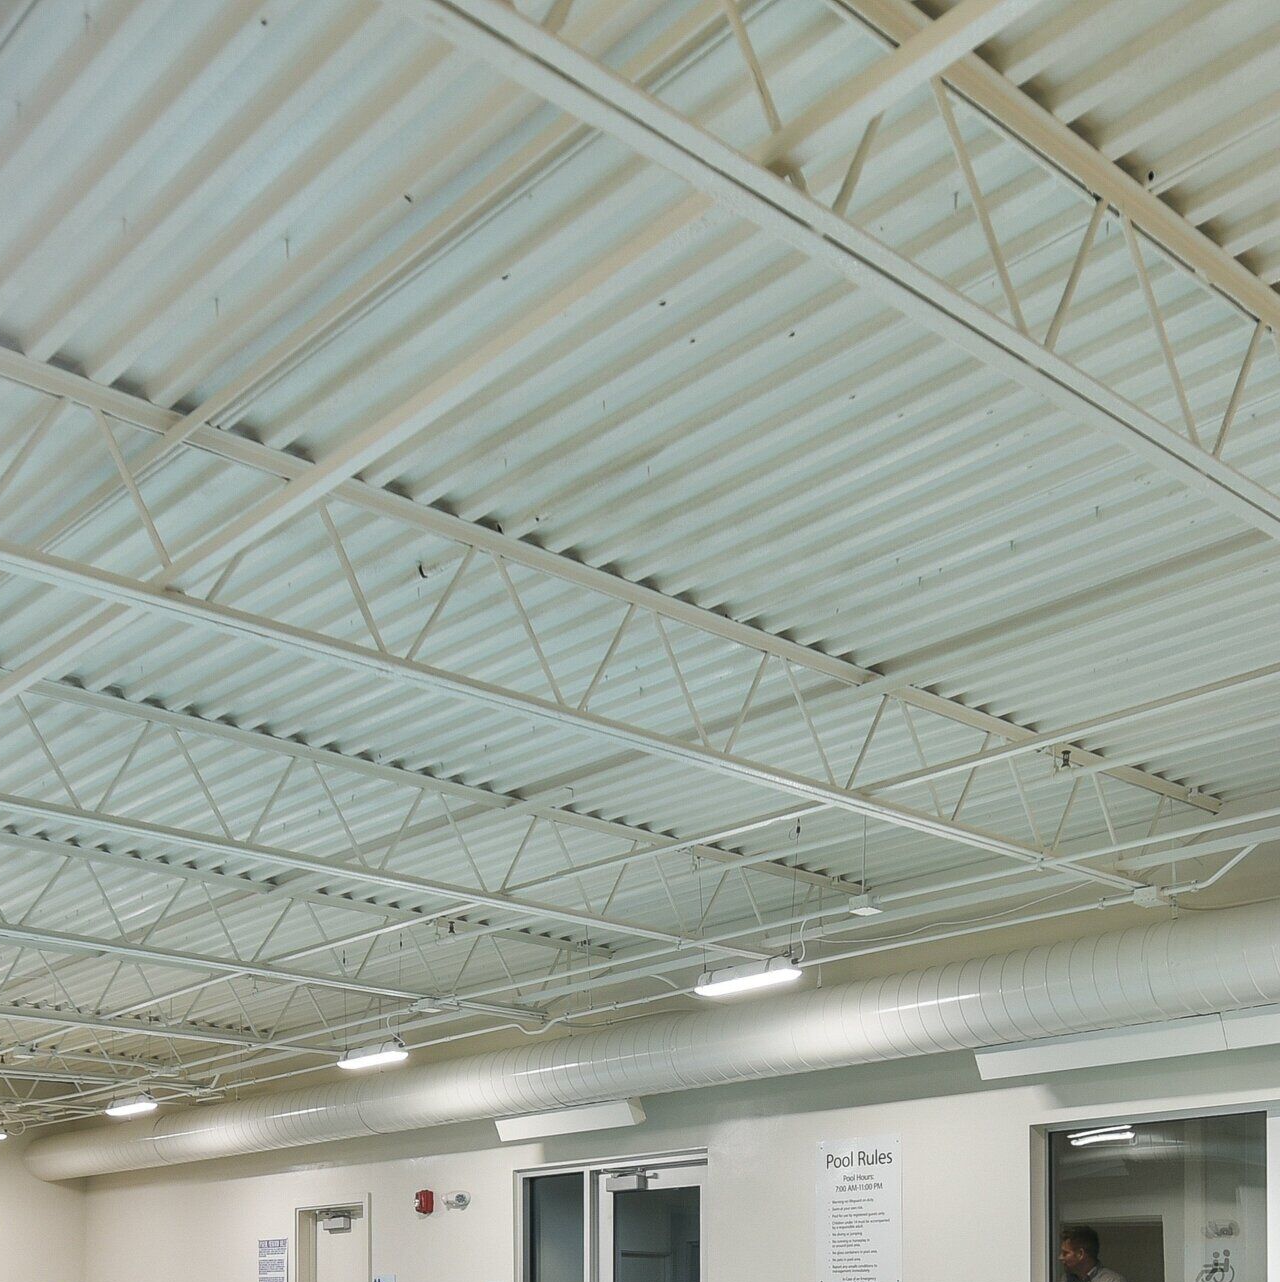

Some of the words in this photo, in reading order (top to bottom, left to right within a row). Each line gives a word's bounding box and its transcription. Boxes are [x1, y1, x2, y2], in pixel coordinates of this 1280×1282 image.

[826, 1151, 853, 1169] Pool
[858, 1149, 893, 1166] Rules
[843, 1174, 855, 1182] Pool
